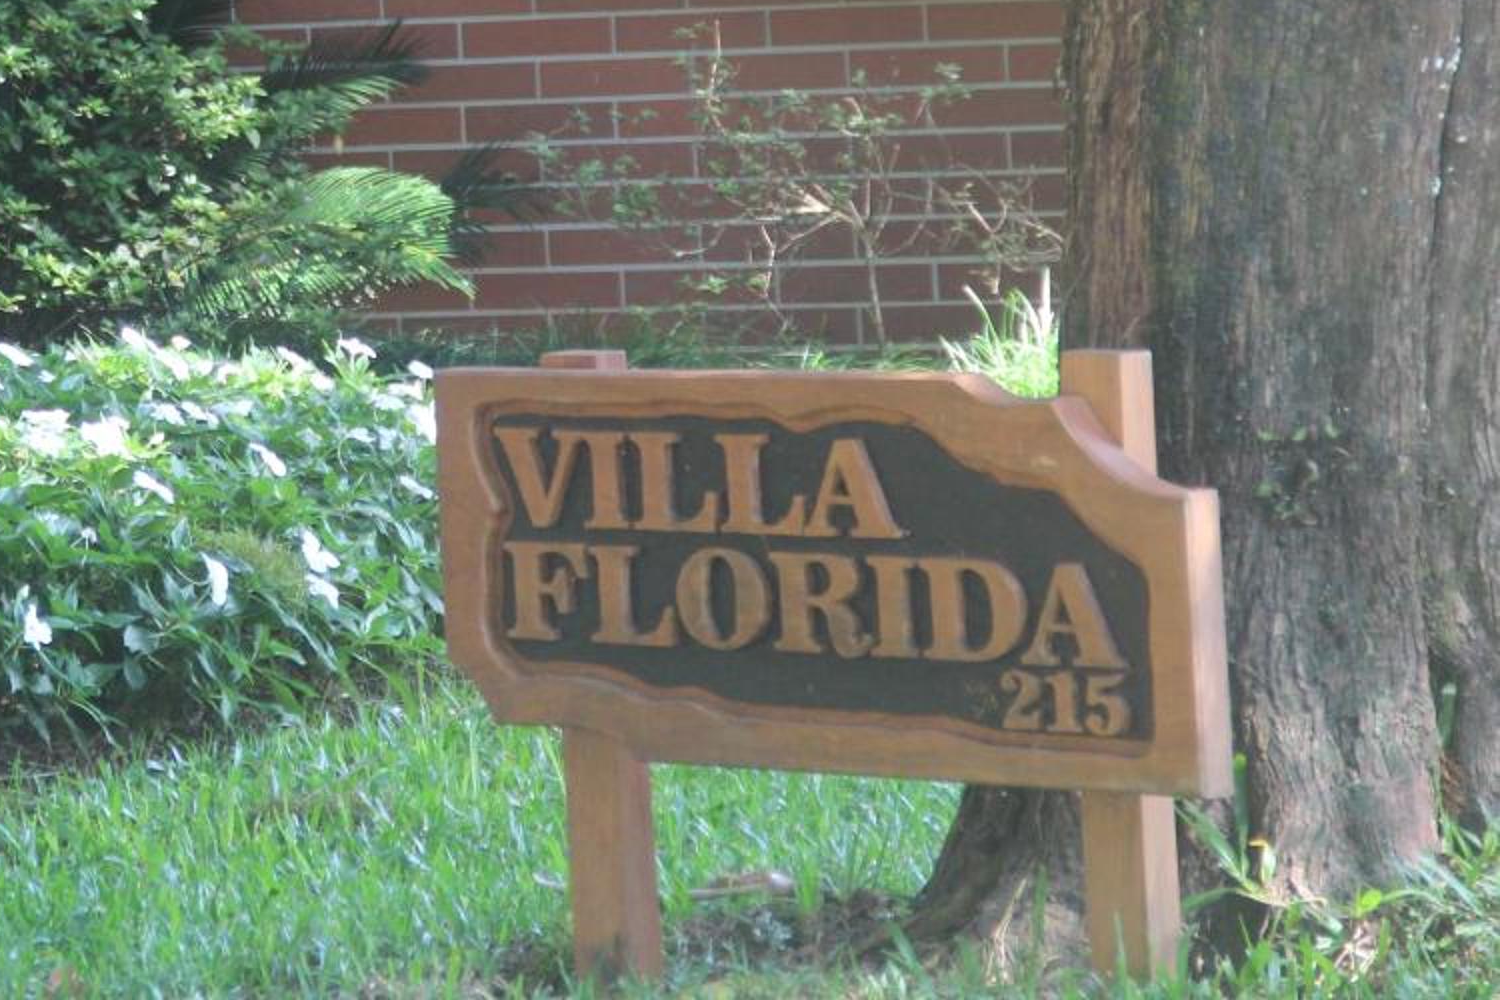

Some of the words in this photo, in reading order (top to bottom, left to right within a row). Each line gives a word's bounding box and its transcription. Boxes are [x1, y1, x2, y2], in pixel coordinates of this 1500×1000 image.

[494, 427, 904, 539] VILLA
[503, 543, 1129, 668] FLORIDA
[1000, 669, 1131, 737] 215
